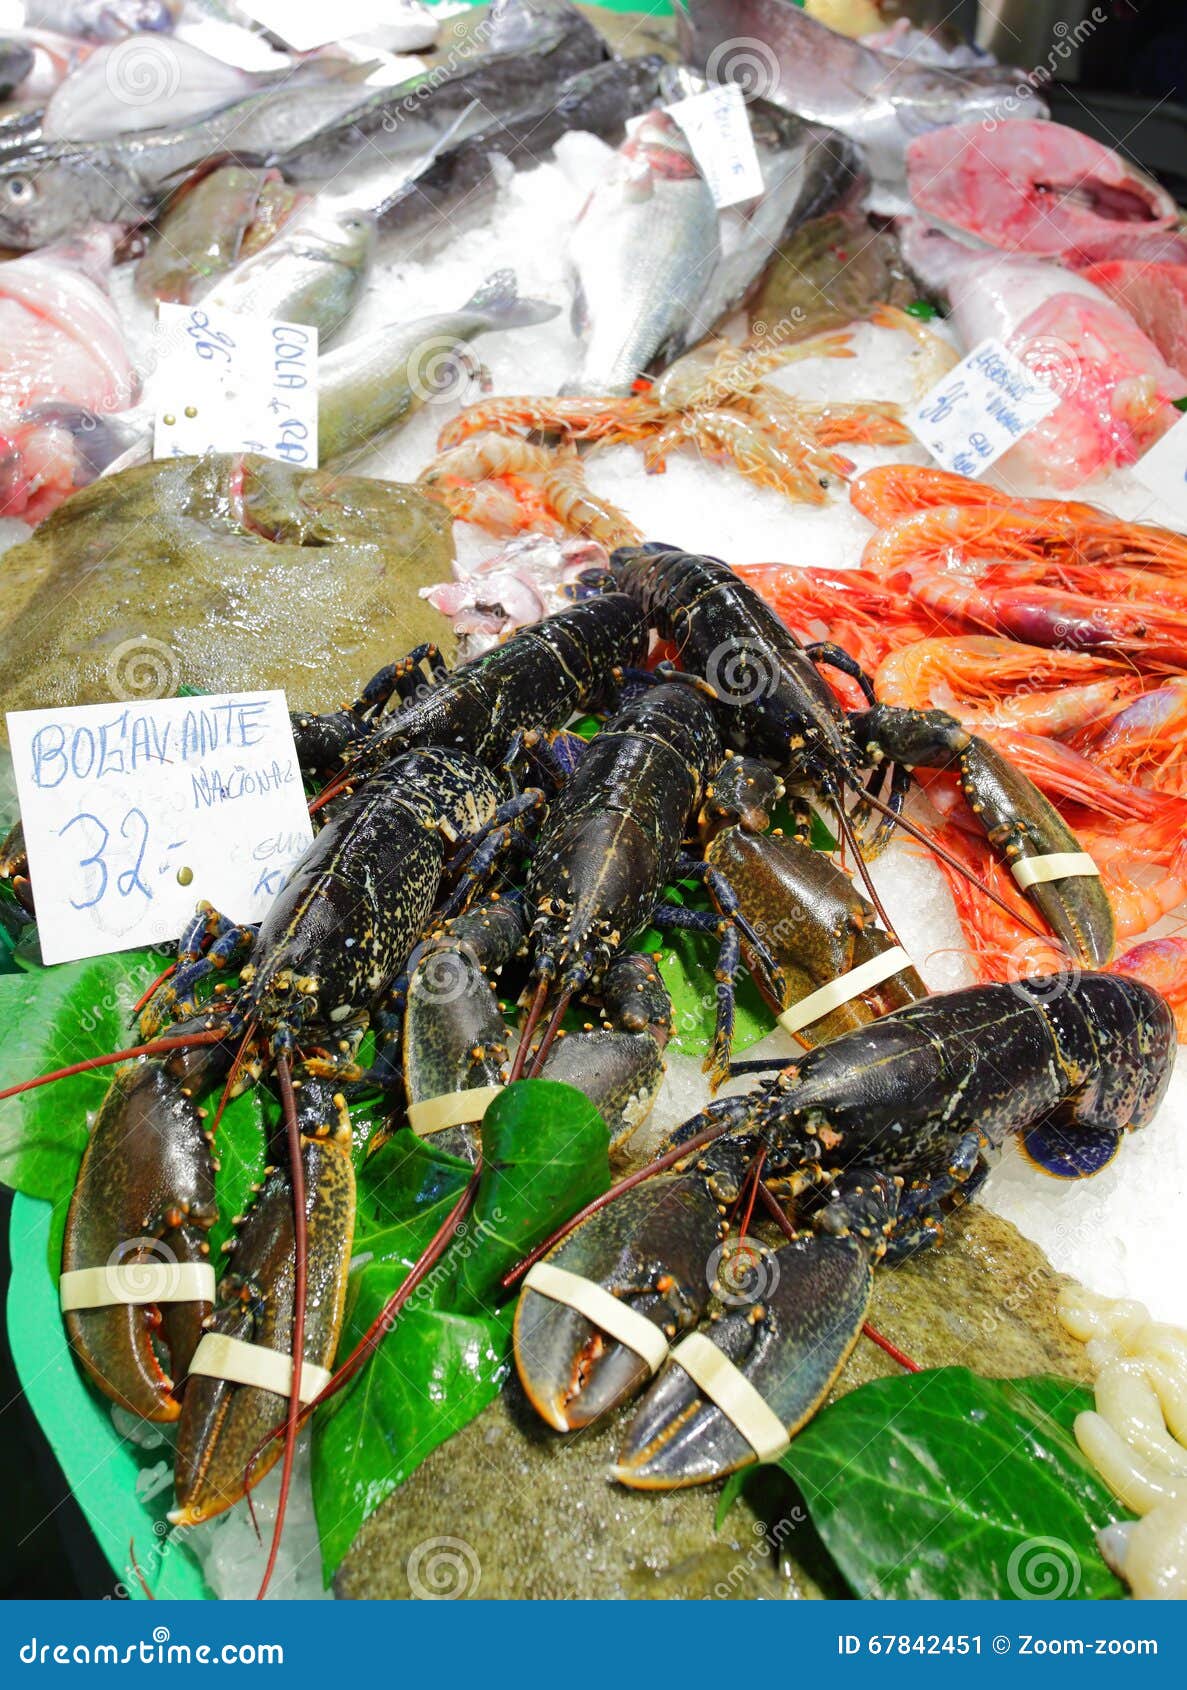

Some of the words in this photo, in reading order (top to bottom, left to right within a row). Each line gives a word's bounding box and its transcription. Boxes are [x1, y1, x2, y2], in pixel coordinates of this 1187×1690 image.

[272, 327, 309, 389] COLA
[275, 419, 308, 463] RA
[31, 702, 271, 788] BOGAVANTE
